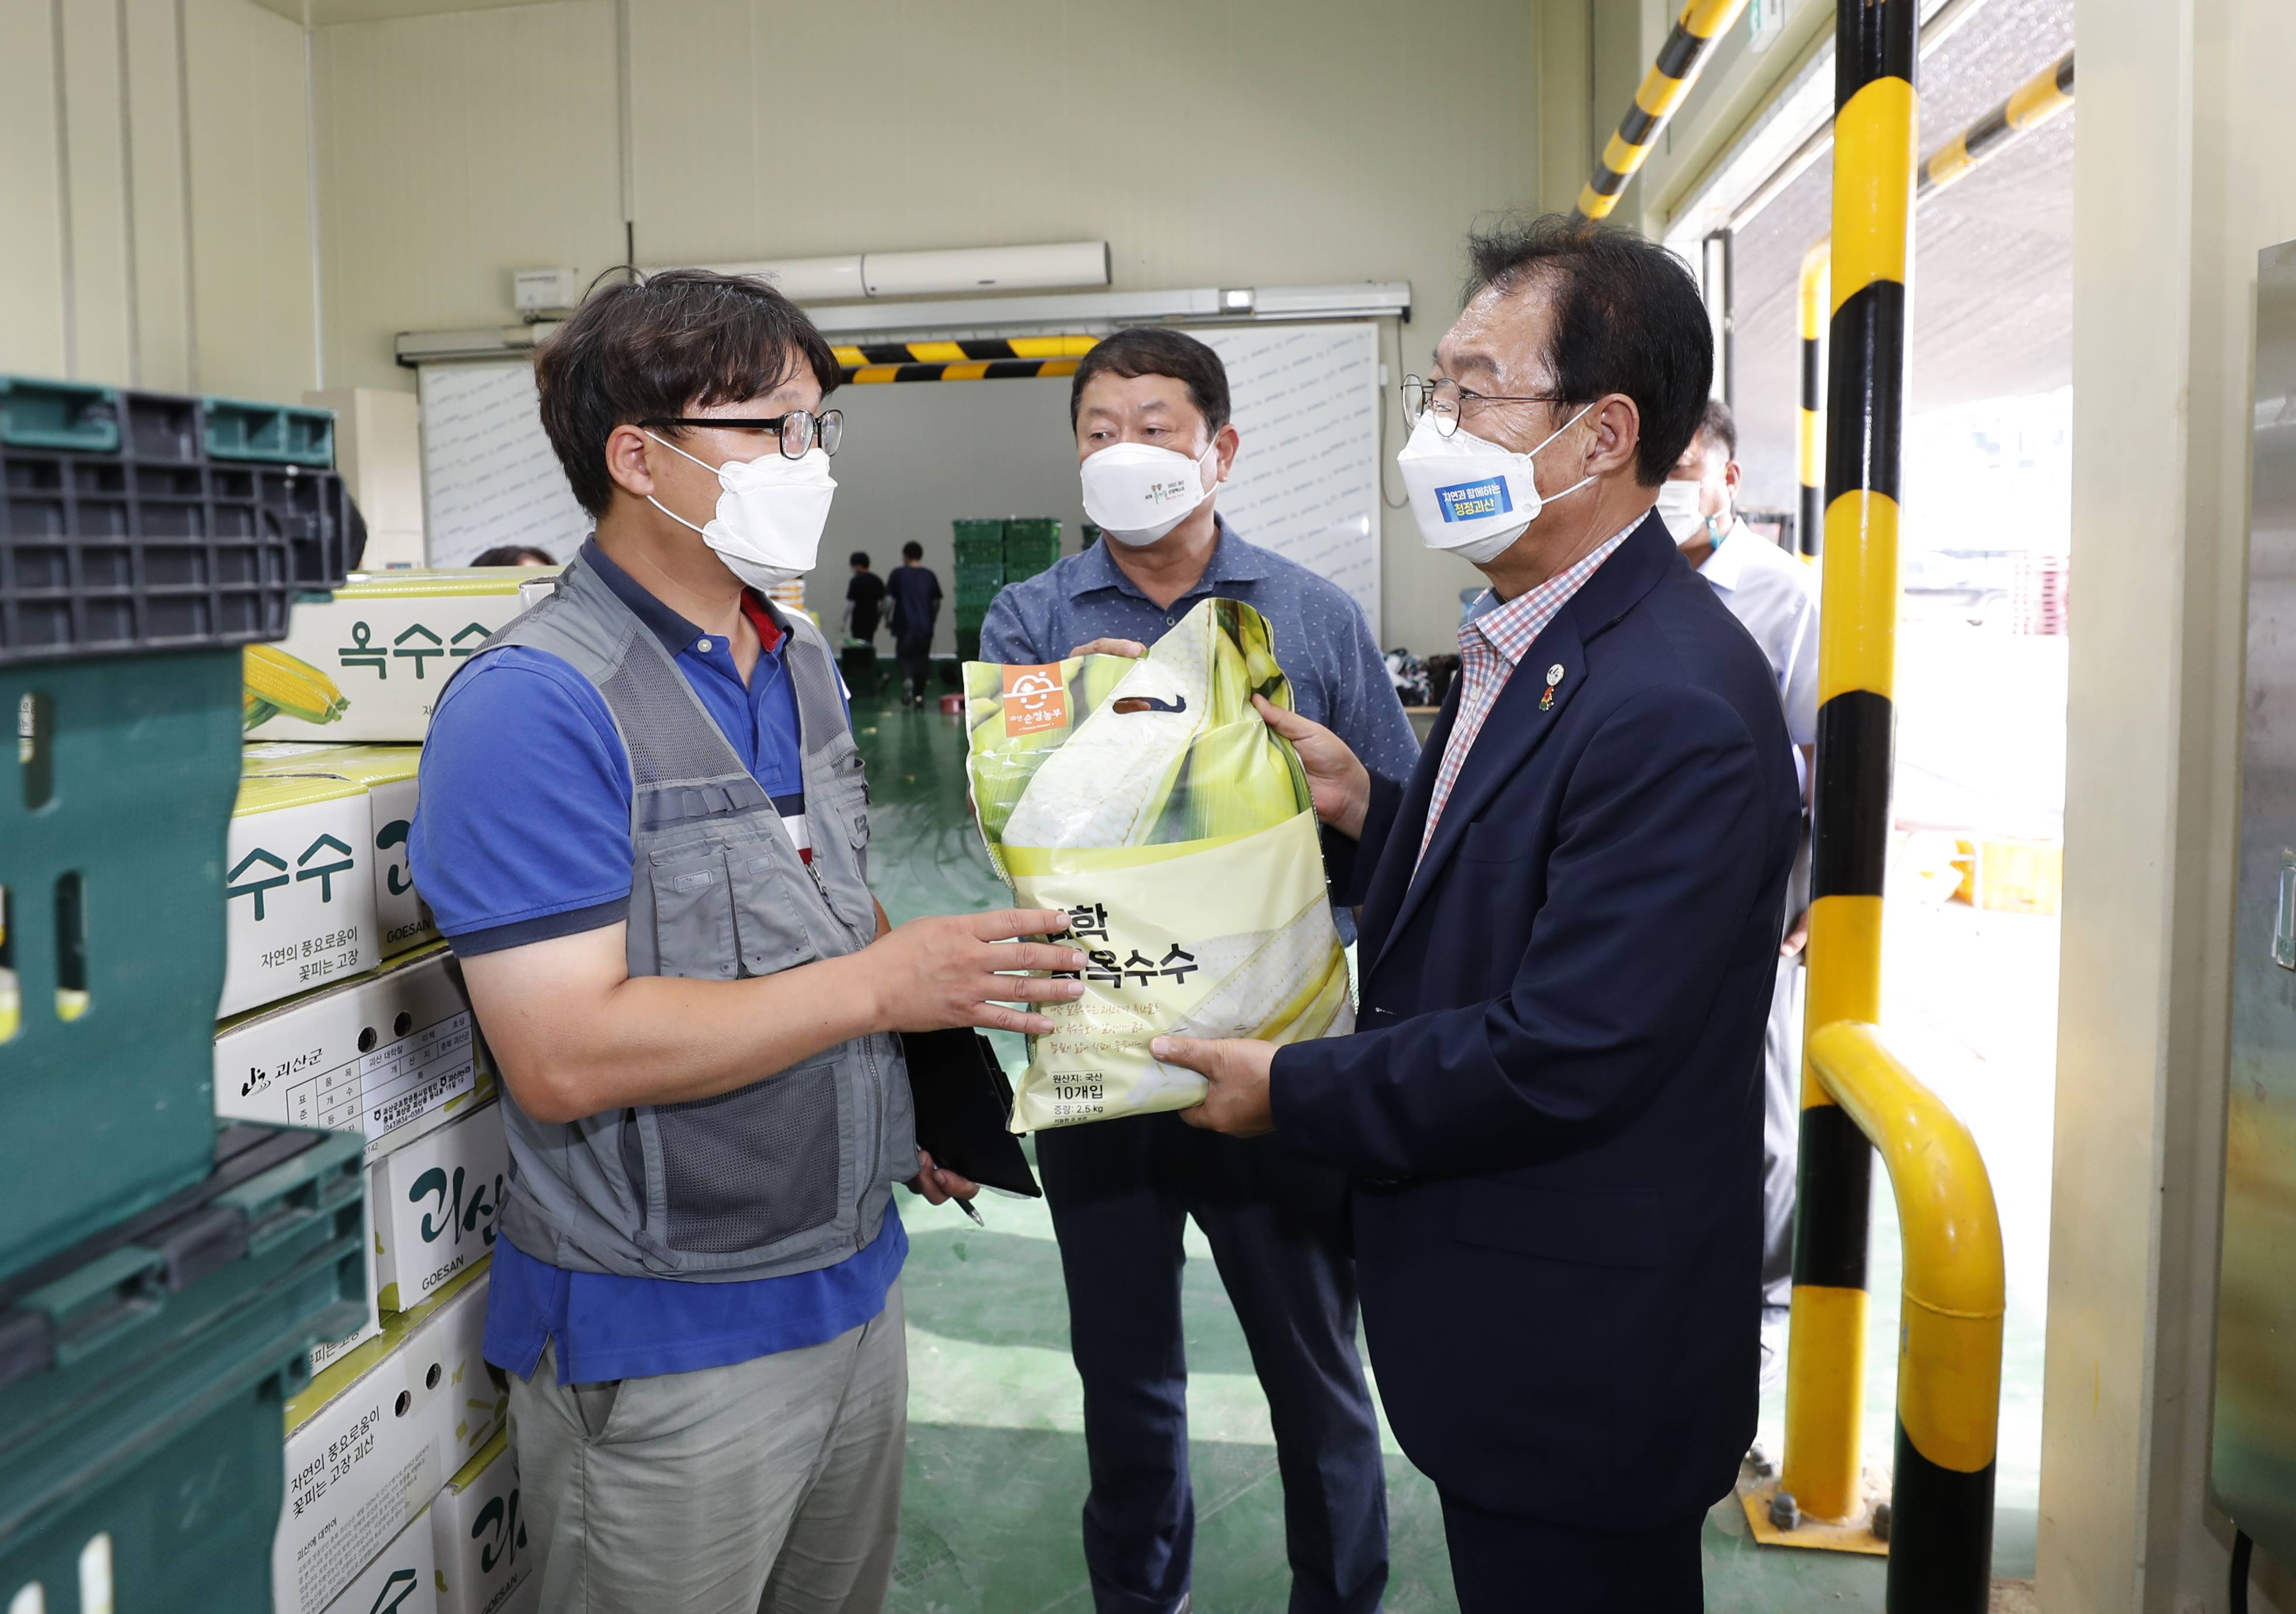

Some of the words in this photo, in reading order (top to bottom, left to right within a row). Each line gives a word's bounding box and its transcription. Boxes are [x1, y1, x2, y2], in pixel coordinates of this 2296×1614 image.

[1442, 489, 1466, 502] 자연과
[1466, 484, 1501, 499] 함께하는
[1454, 498, 1495, 516] 청정괴산
[1024, 708, 1062, 724] 순정농부
[387, 918, 430, 943] GOESAN
[261, 944, 297, 969] 자연의
[301, 926, 358, 958] 풍요로움이
[299, 959, 333, 983] 꽃피는
[337, 949, 358, 970] 고장
[1051, 943, 1199, 989] 옥수수
[275, 1048, 323, 1078] 괴산군
[369, 1054, 382, 1066] 괴산
[1053, 1074, 1082, 1083] 원산지:
[1085, 1073, 1103, 1082] 국산
[1055, 1085, 1103, 1100] 10개입
[1054, 1105, 1073, 1115] 중량:
[1077, 1105, 1090, 1113] 2.5
[1093, 1105, 1103, 1113] kg
[422, 1254, 464, 1290] GOESAN
[291, 1454, 324, 1493] 자연의
[327, 1406, 379, 1462] 풍요로움이
[293, 1480, 327, 1520] 꽃피는
[330, 1454, 351, 1486] 고장
[354, 1434, 375, 1463] 괴산
[297, 1536, 316, 1561] 괴산에
[318, 1517, 337, 1541] 대하여
